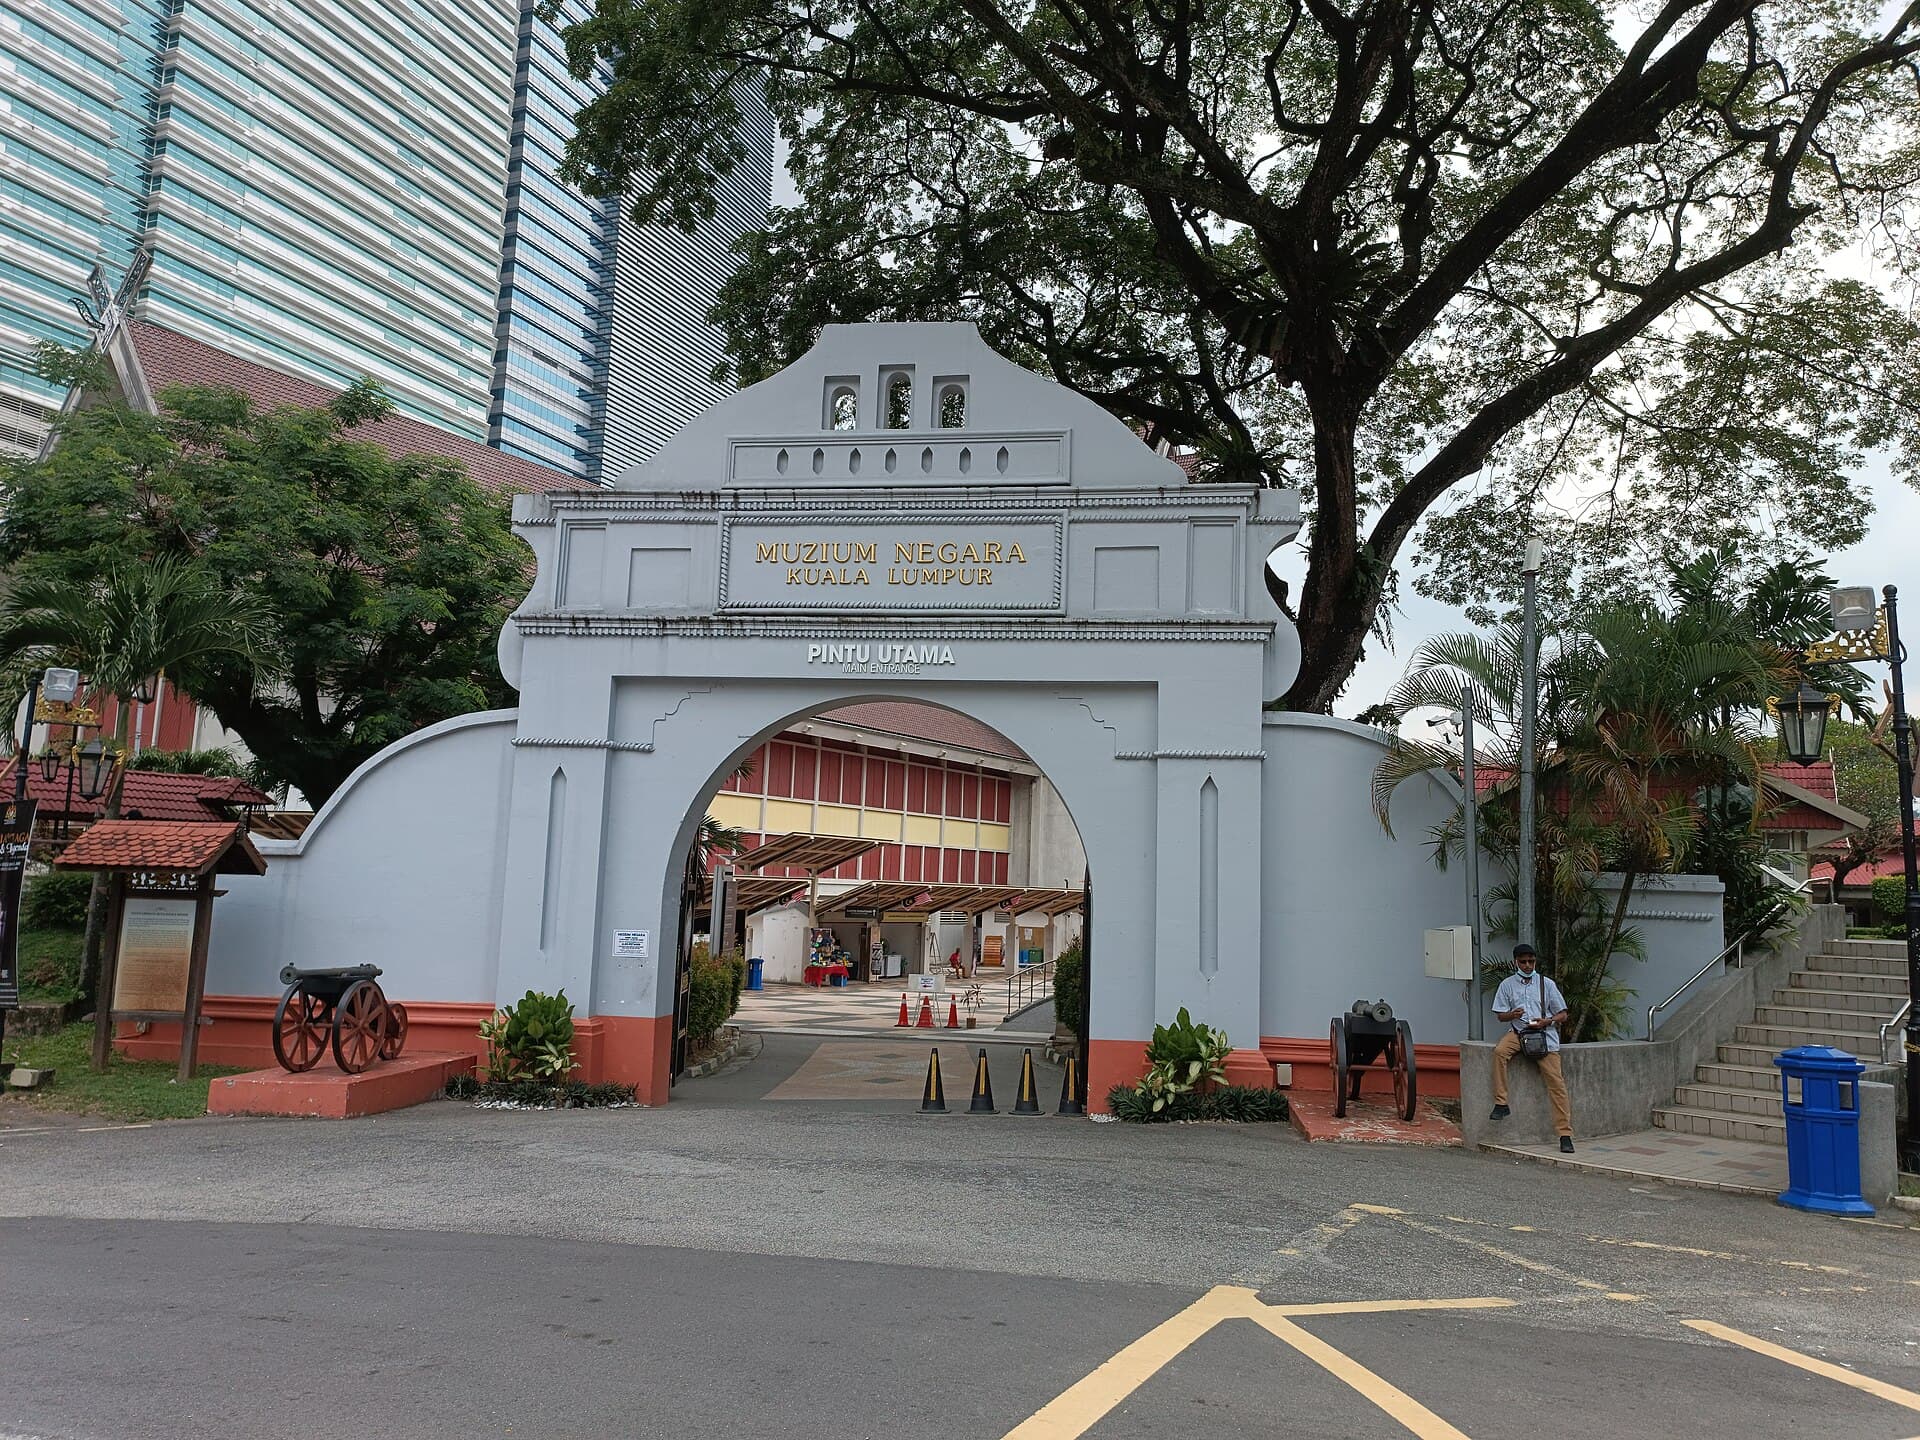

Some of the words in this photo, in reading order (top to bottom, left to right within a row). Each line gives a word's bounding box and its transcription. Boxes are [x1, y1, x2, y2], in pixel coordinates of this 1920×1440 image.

[755, 542, 878, 564] MUZIUM
[894, 541, 1027, 564] NEGARA
[786, 568, 870, 585] KUALA
[888, 568, 992, 585] LUMPUR
[807, 643, 870, 664] PINTU
[878, 643, 955, 665] UTAMA
[842, 663, 868, 673] MAIN
[870, 663, 921, 674] ENTRANCE
